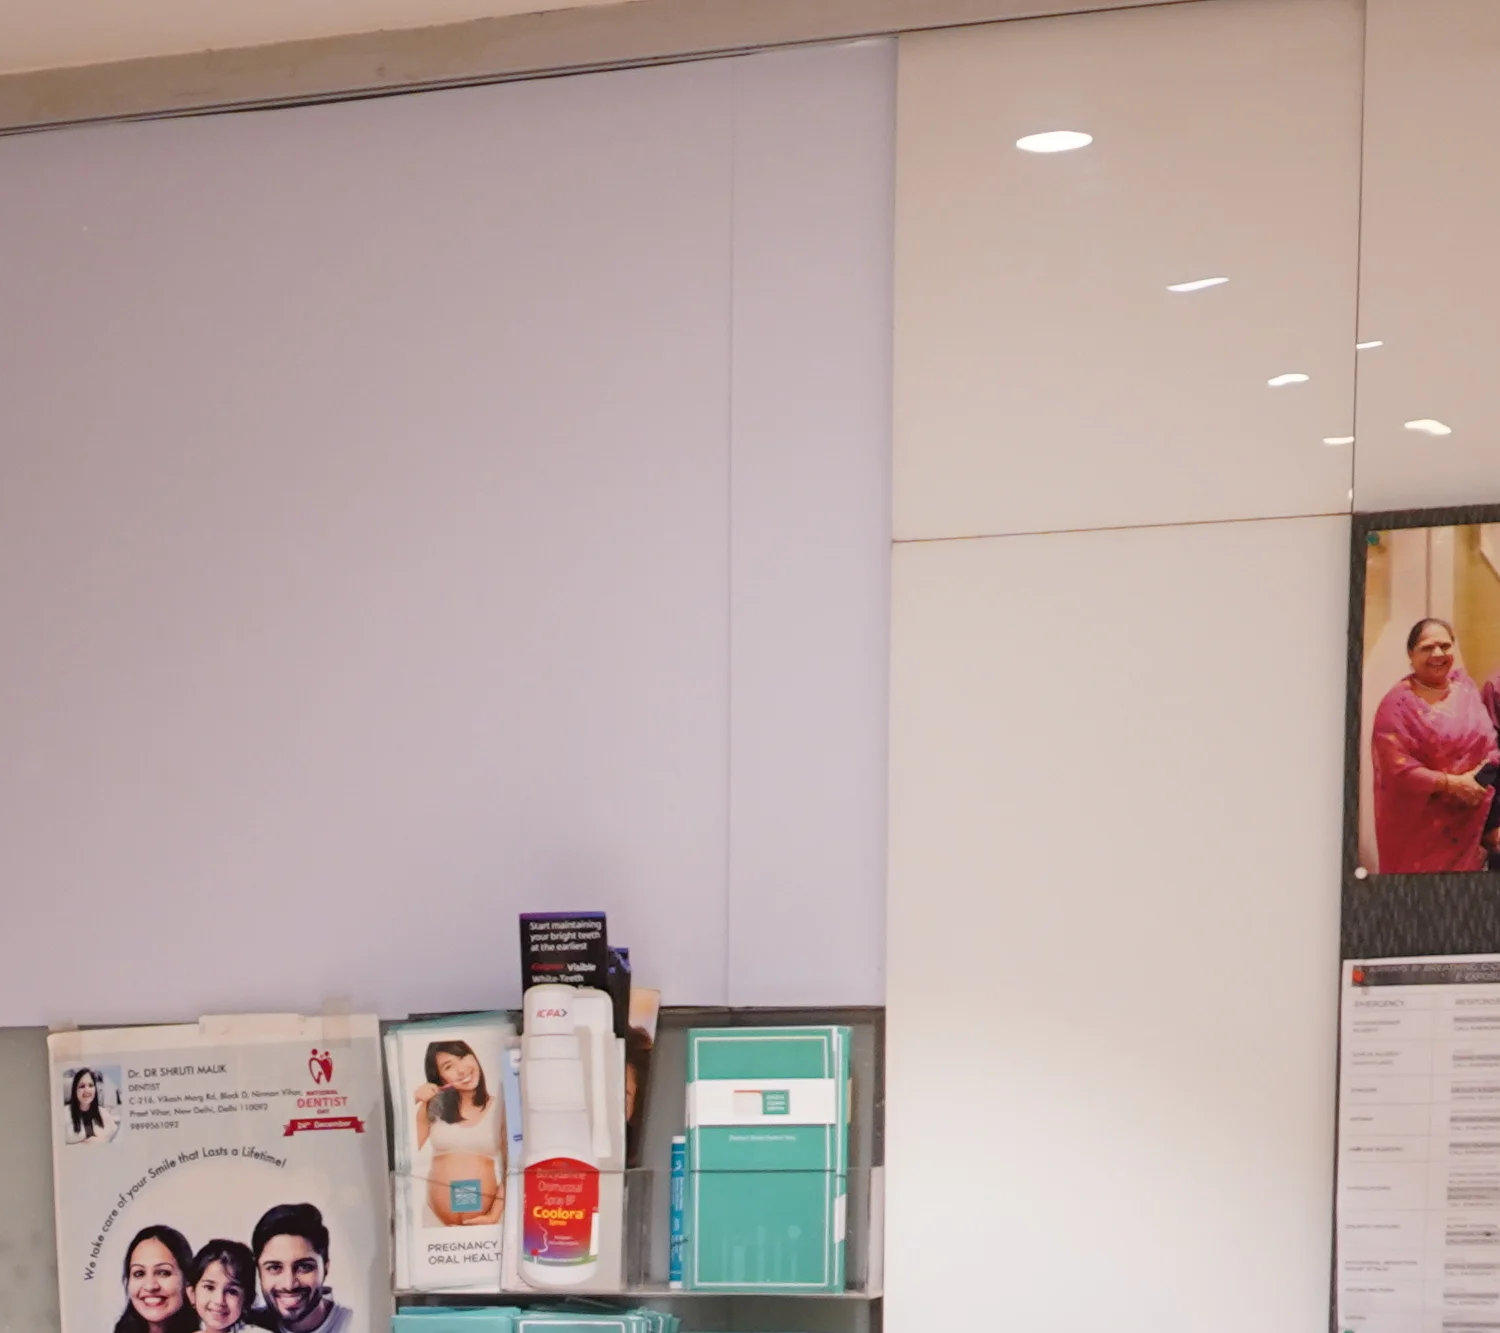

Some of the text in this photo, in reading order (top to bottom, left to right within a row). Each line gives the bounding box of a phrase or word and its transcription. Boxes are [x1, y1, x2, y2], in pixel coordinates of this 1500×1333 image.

[529, 921, 601, 930] Start maintaining
[530, 931, 601, 942] your bright teeth
[541, 943, 554, 951] the
[556, 942, 587, 950] earliest
[567, 963, 596, 971] Visible
[537, 1010, 560, 1018] ICPA
[128, 1065, 227, 1078] Dr. DR SHRUTI MALIK
[128, 1083, 160, 1091] DENTIST
[185, 1095, 203, 1103] Marg
[297, 1097, 348, 1108] DENTIST
[218, 1104, 237, 1113] Delhi
[240, 1103, 268, 1111] 110092
[130, 1121, 179, 1130] 9899561092
[545, 1195, 564, 1207] Spray
[84, 1262, 96, 1281] We
[90, 1235, 105, 1263] take
[102, 1209, 118, 1232] care
[117, 1194, 129, 1209] of
[124, 1178, 147, 1199] your
[148, 1157, 177, 1179] Smile
[178, 1150, 199, 1164] that
[203, 1147, 228, 1158] Lasts
[242, 1147, 287, 1168] Lifetime!
[533, 1206, 584, 1220] Coolora
[428, 1241, 498, 1252] PREGNANCY
[428, 1252, 501, 1265] ORAL HEALT
